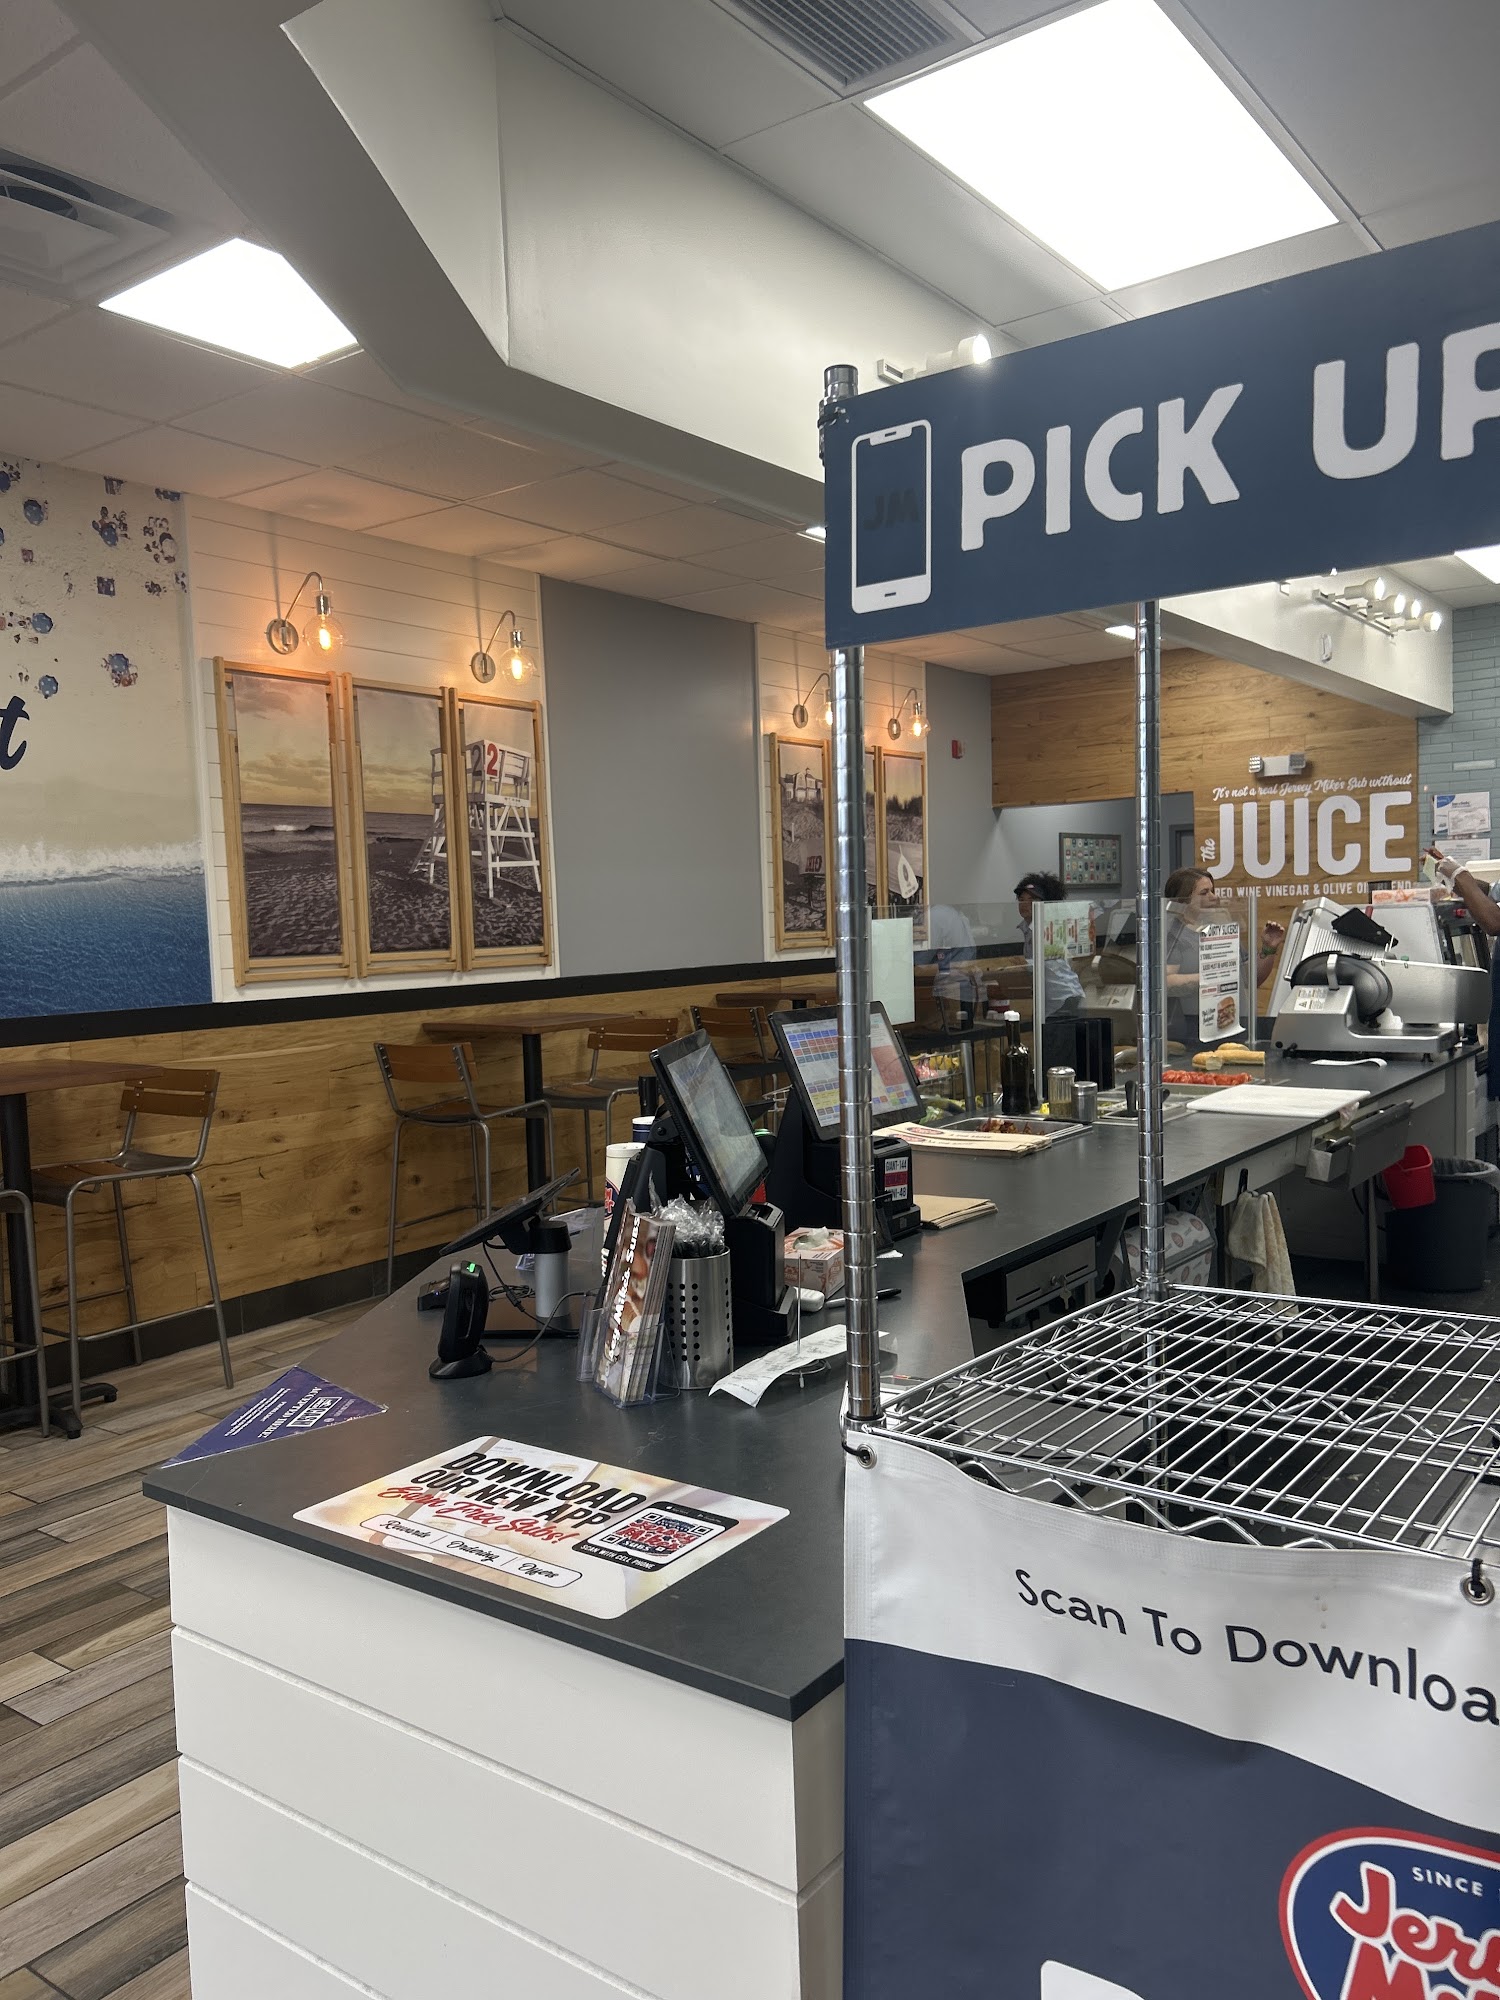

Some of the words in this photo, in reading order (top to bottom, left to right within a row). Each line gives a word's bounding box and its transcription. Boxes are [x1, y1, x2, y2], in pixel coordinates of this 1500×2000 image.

[961, 383, 1243, 552] PICK
[863, 488, 920, 531] JM
[486, 743, 498, 777] 2
[1213, 786, 1230, 801] It's
[1232, 787, 1248, 798] not
[1249, 787, 1256, 796] a
[1258, 782, 1277, 795] real
[1279, 781, 1312, 798] Jersey
[1314, 777, 1344, 793] Mike's
[1347, 776, 1367, 790] Sub
[1369, 773, 1412, 788] without
[1201, 838, 1216, 862] the
[1207, 791, 1412, 880] JUICE
[1215, 887, 1232, 898] RED
[1237, 885, 1261, 898] WINE
[1266, 884, 1309, 897] VINEGAR
[1313, 883, 1321, 896] &
[1323, 882, 1353, 895] OLIVE
[613, 1266, 631, 1325] Mike's
[410, 1469, 479, 1495] OUR
[467, 1484, 550, 1512] NEW
[538, 1502, 611, 1529] APP
[441, 1452, 647, 1514] DOWNLOAD
[378, 1486, 445, 1508] Earn
[435, 1501, 506, 1526] Free
[502, 1517, 581, 1545] Subs!
[380, 1516, 431, 1539] Rewards
[446, 1540, 501, 1563] Ordering
[517, 1562, 560, 1579] Offers
[581, 1544, 600, 1555] SCAN
[599, 1549, 615, 1559] WITH
[615, 1554, 631, 1564] CELL
[631, 1558, 655, 1570] PHONE
[1015, 1569, 1127, 1635] Scan
[1142, 1607, 1202, 1655] To
[1226, 1625, 1500, 1726] Downloa
[1411, 1866, 1484, 1898] SINCE
